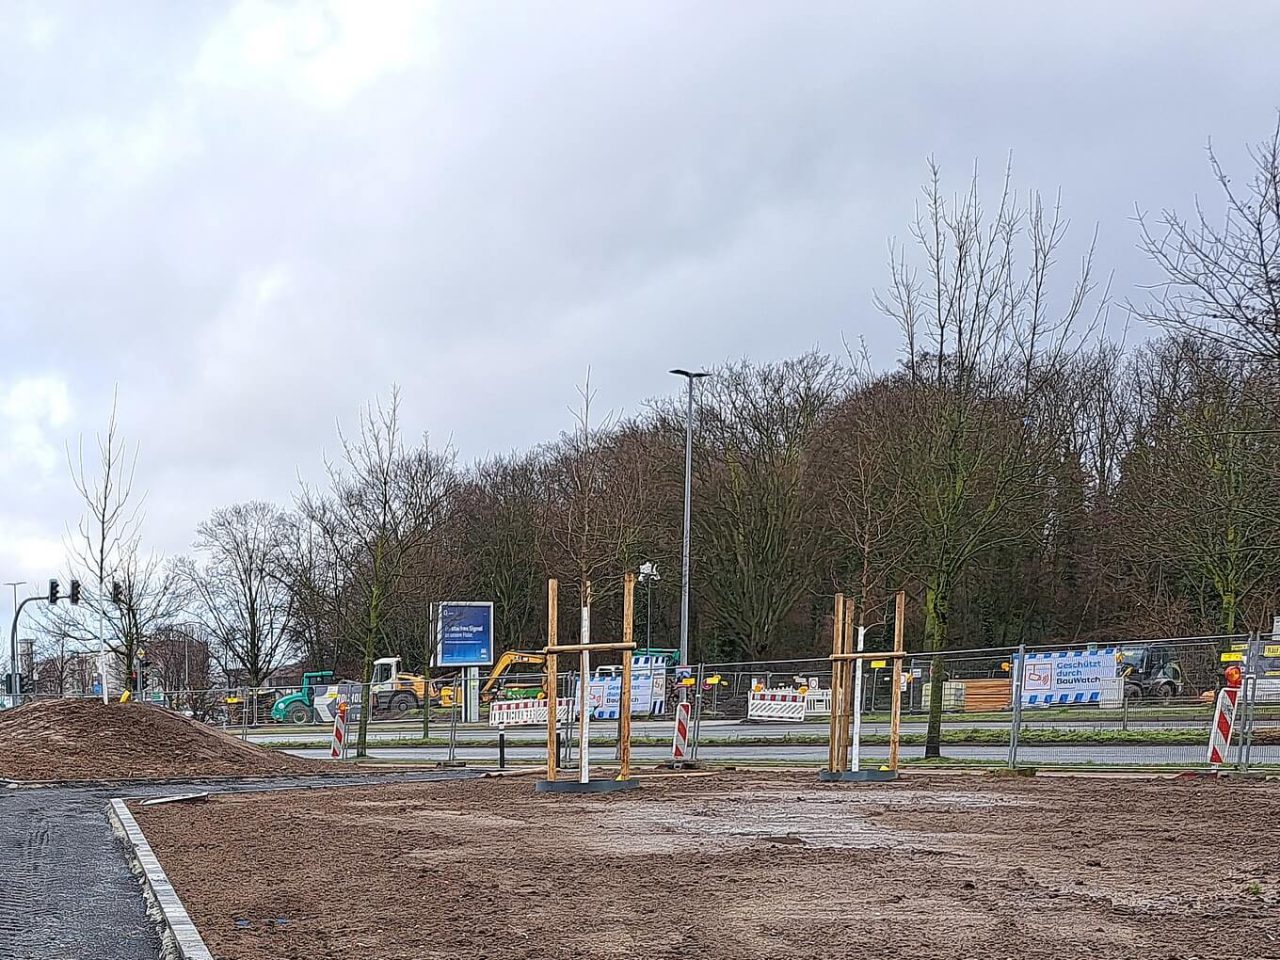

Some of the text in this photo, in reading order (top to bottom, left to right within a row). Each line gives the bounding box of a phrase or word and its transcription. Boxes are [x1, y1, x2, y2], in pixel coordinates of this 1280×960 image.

[1056, 660, 1101, 669] Geschützt
[1056, 669, 1082, 677] durch
[1056, 677, 1100, 685] BauWatch
